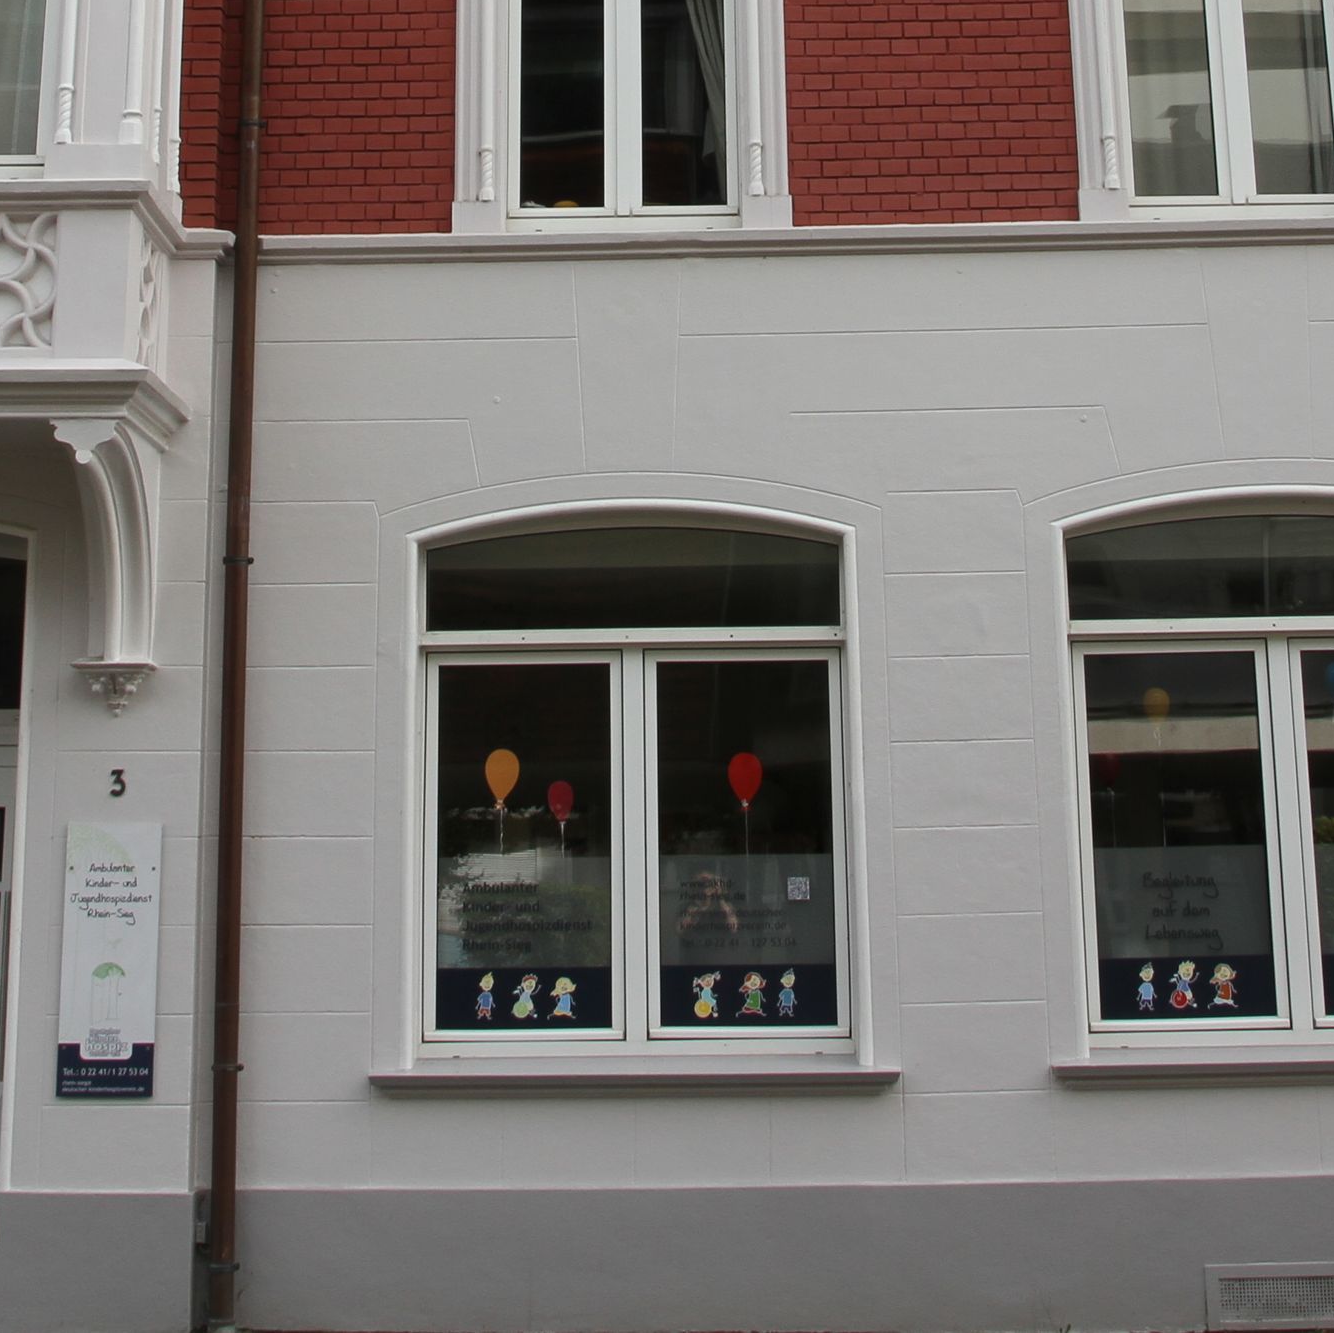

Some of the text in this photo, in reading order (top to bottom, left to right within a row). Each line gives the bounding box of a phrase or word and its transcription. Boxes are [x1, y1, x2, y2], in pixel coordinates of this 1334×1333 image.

[110, 768, 126, 797] 3
[89, 862, 135, 873] Ambulanter
[85, 876, 138, 888] Kinder- und
[463, 882, 540, 893] Ambulanter
[1142, 871, 1219, 899] Begleitung
[70, 892, 153, 911] Jugendhospizdienst
[515, 900, 540, 912] und
[1152, 900, 1210, 917] auf dem
[87, 907, 137, 926] Rhein-Sieg
[462, 919, 592, 933] Jugendhospizdienst
[1145, 923, 1224, 951] Lebensweg
[462, 938, 532, 953] Rhein-Sieg
[87, 1067, 97, 1076] 22
[118, 1067, 127, 1076] 27
[128, 1067, 138, 1076] 53
[139, 1067, 149, 1076] 04
